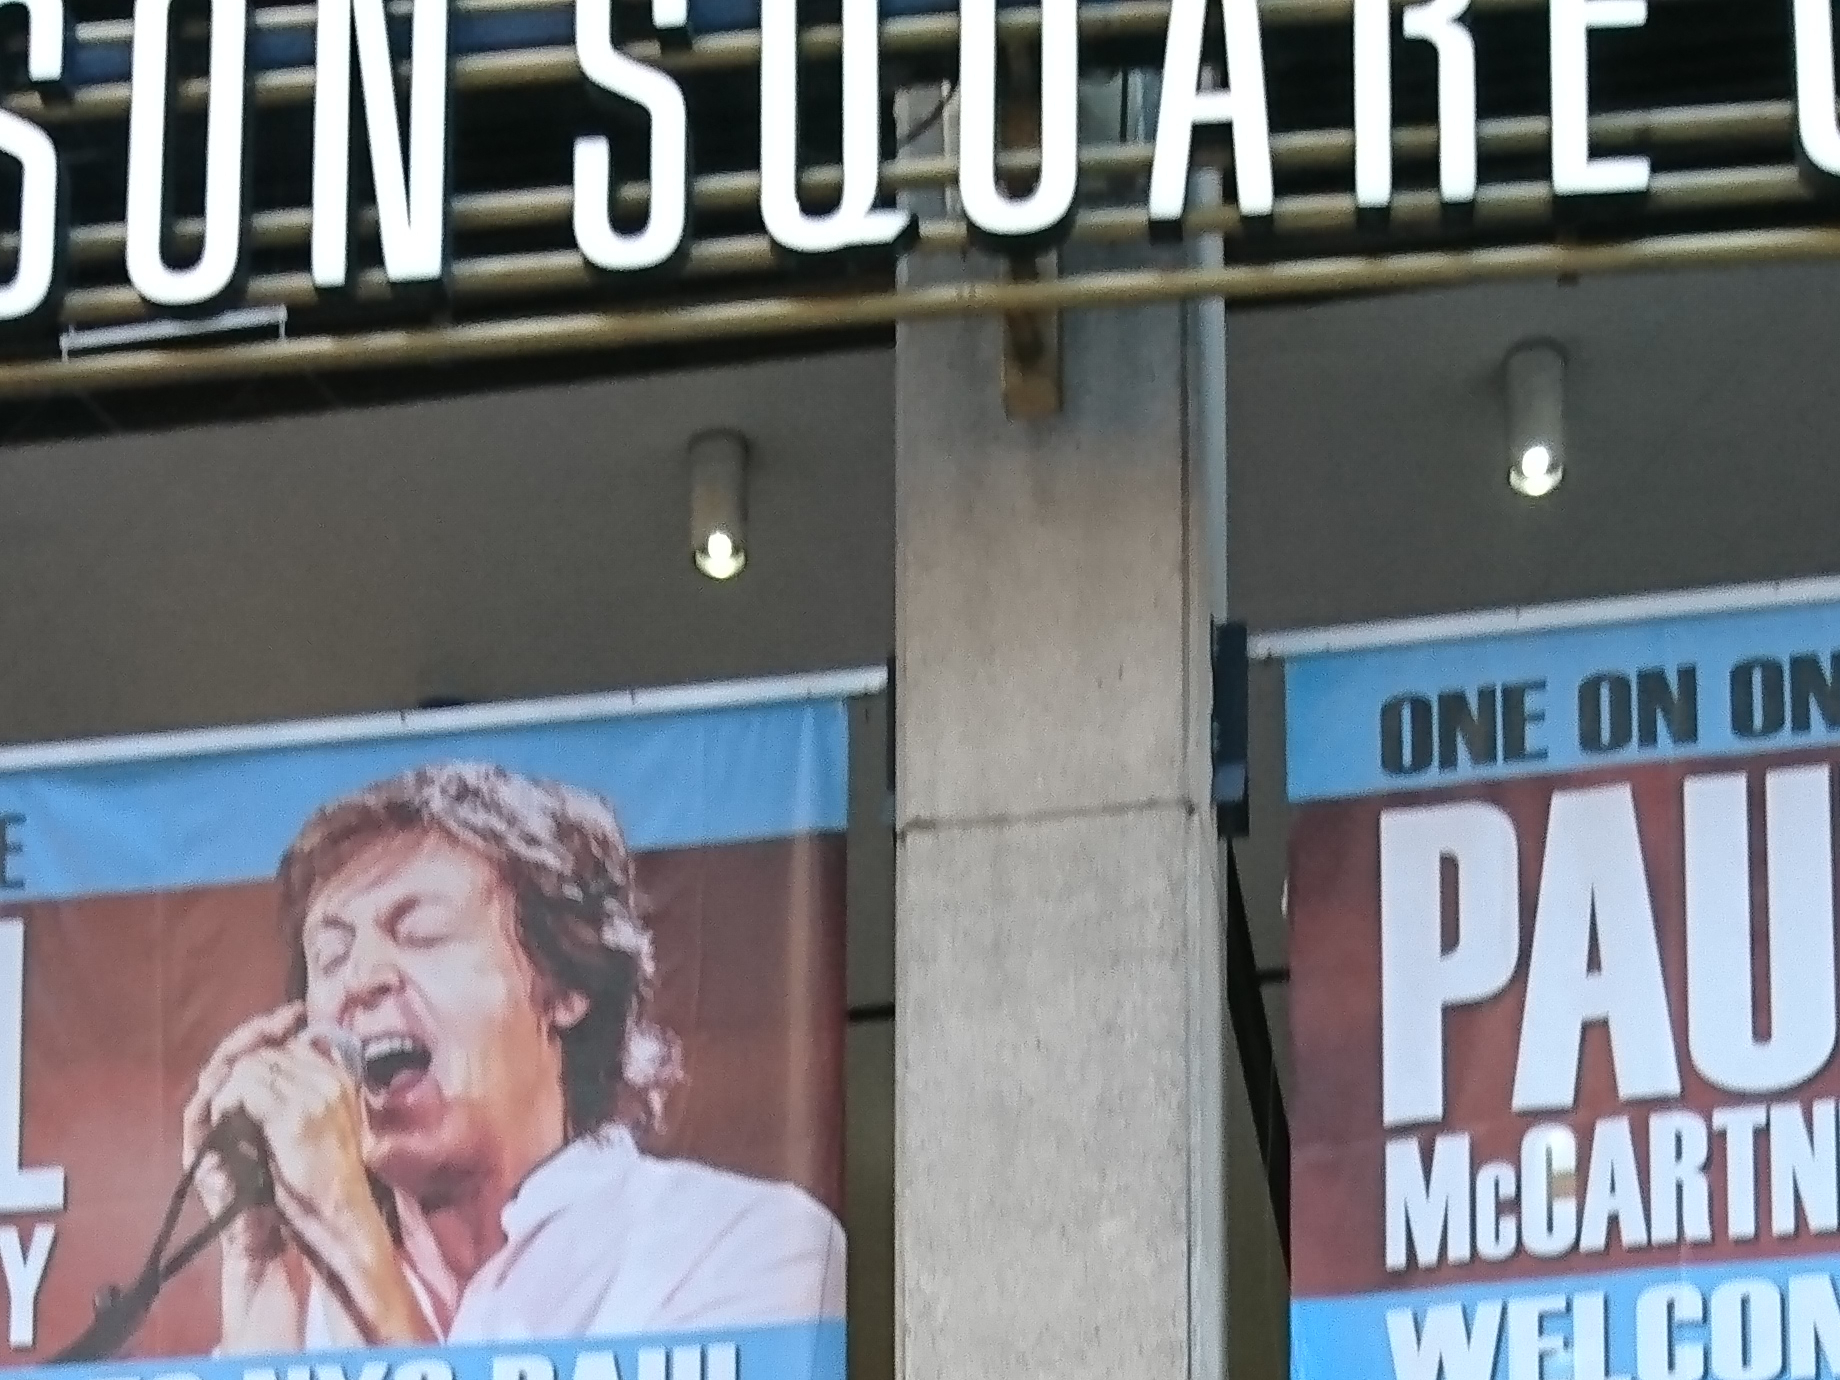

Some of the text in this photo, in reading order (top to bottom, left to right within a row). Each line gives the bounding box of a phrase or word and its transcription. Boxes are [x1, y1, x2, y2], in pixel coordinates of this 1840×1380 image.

[572, 0, 1652, 272] SQUARE
[1380, 678, 1549, 776] ONE
[1577, 663, 1698, 753] ON
